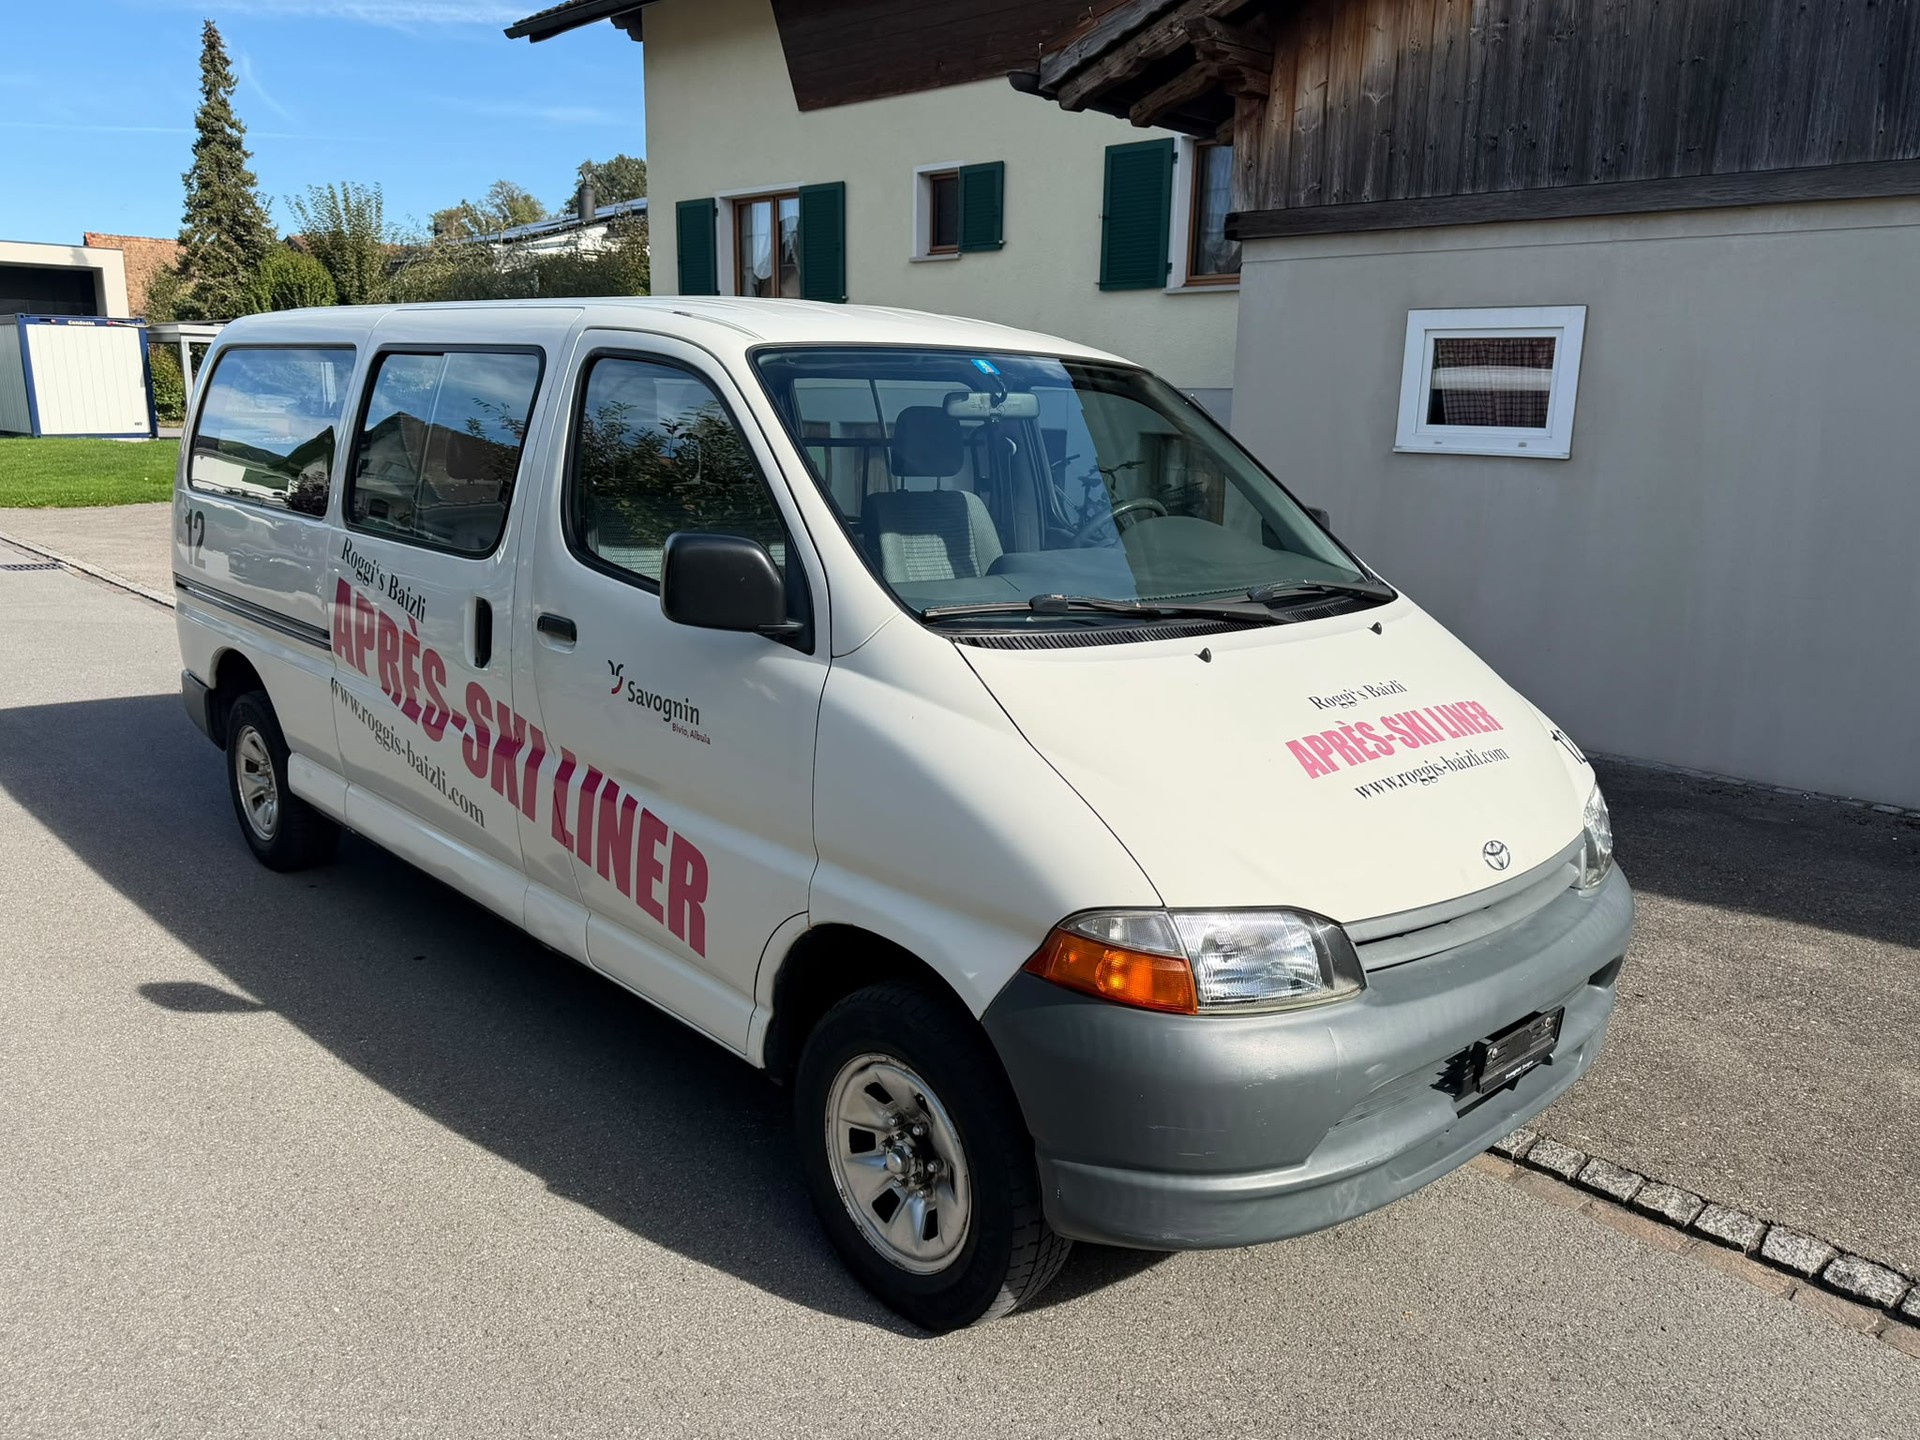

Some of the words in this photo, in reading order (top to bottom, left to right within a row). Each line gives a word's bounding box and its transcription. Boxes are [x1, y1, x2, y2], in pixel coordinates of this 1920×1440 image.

[185, 508, 205, 569] 12
[387, 573, 425, 624] Baizli
[627, 680, 700, 726] Savognin
[1362, 680, 1408, 698] Baizli
[330, 677, 485, 828] www.roggis-baizli.com
[672, 722, 690, 738] Bivio,
[689, 730, 711, 745] Albula
[1285, 709, 1444, 779] APRÈS-SKI
[1434, 700, 1504, 739] LINER
[330, 576, 546, 822] APRÈS-SKI
[552, 746, 710, 959] LINER
[1354, 747, 1510, 800] www.roggis-baizli.com
